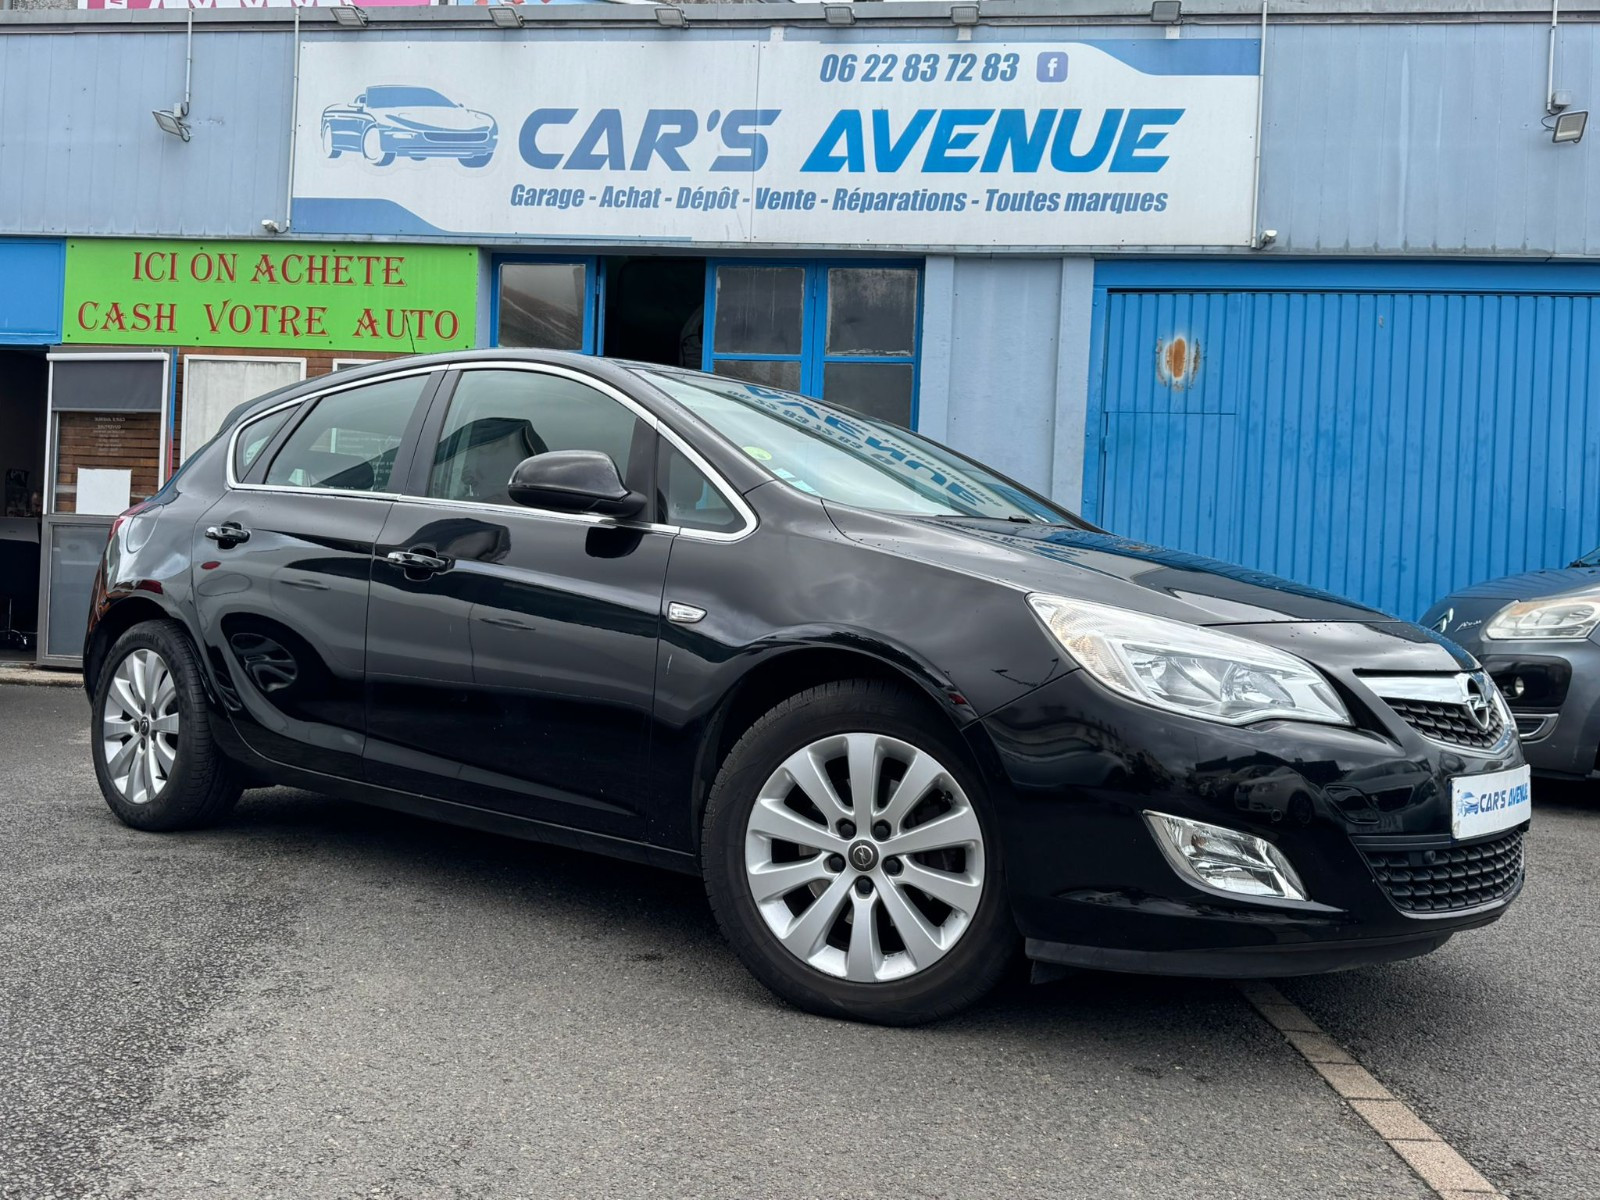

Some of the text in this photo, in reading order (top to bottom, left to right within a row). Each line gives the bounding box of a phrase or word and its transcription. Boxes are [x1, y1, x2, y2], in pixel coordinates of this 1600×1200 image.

[819, 53, 1020, 82] 06 22 83 72 83
[518, 108, 1187, 173] CAR'S AVENUE
[510, 184, 586, 210] Garage
[598, 186, 662, 208] Achat
[675, 186, 740, 211] Dépôt
[754, 188, 817, 210] Vente
[832, 188, 968, 213] Réparations
[985, 189, 1060, 212] Toutes
[1063, 192, 1168, 214] marques
[132, 251, 406, 287] ICI ON ACHETE
[77, 299, 459, 340] CASH VOTRE AUTO
[1479, 782, 1529, 813] CAR'S AVENUE
